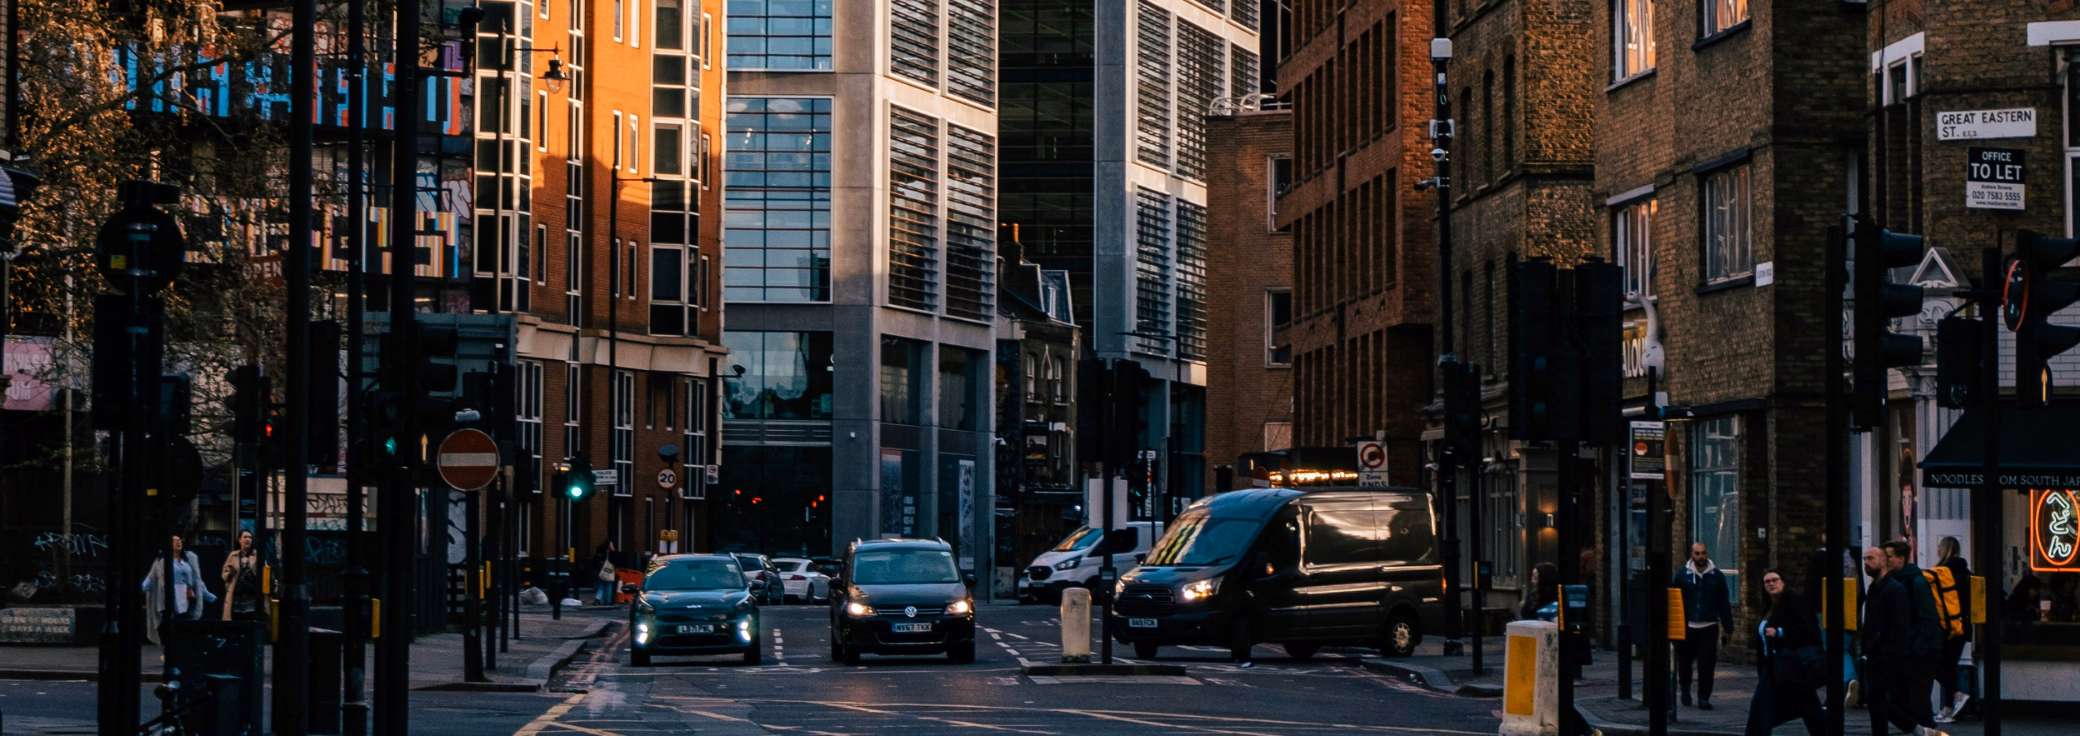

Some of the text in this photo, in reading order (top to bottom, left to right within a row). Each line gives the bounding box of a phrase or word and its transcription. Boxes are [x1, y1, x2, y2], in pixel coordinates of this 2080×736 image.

[1941, 110, 2032, 124] GREAT EASTERN
[1942, 126, 1960, 138] ST.
[1981, 151, 2012, 162] OFFICE
[1970, 162, 2022, 180] TO LET
[1972, 190, 1985, 200] 020
[242, 260, 282, 280] OPEN
[659, 473, 676, 484] 20
[1931, 474, 1984, 485] NOODLES
[2020, 475, 2060, 486] SOUTH
